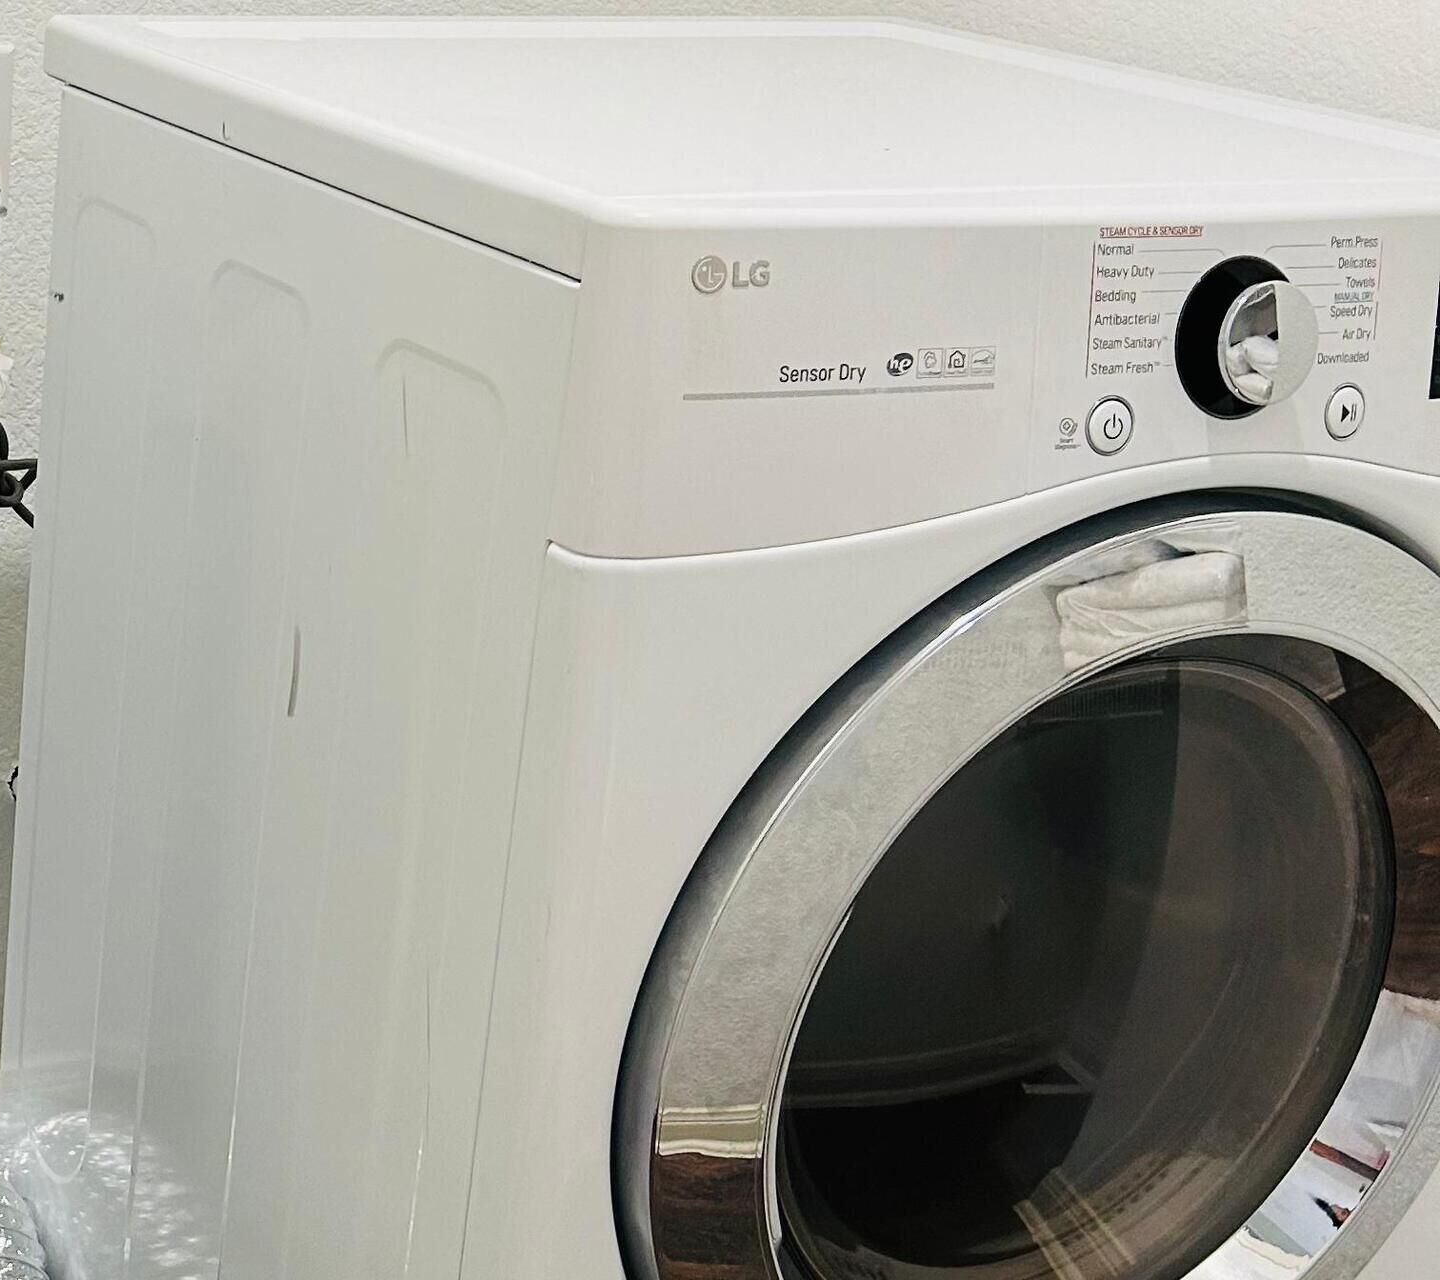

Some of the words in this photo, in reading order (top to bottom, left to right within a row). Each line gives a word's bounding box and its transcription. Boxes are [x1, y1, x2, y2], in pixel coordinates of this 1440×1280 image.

[1100, 226, 1126, 237] STEAM
[1127, 226, 1151, 236] CYCLE
[1097, 243, 1135, 256] Normal
[1338, 257, 1377, 269] Delicates
[732, 260, 770, 287] LG
[1096, 266, 1129, 280] Heavy
[1130, 265, 1155, 278] Duty
[1345, 276, 1376, 288] Towels
[1094, 290, 1137, 304] Bedding
[1330, 305, 1357, 320] Speed
[1358, 304, 1373, 318] Dry
[1094, 313, 1160, 326] Antibacterial
[1342, 328, 1355, 340] Air
[1356, 328, 1371, 341] Dry
[1092, 338, 1122, 350] Steam
[1317, 351, 1370, 365] Downloaded
[779, 365, 836, 383] Sensor
[839, 363, 866, 384] Dry
[1090, 363, 1123, 375] Steam
